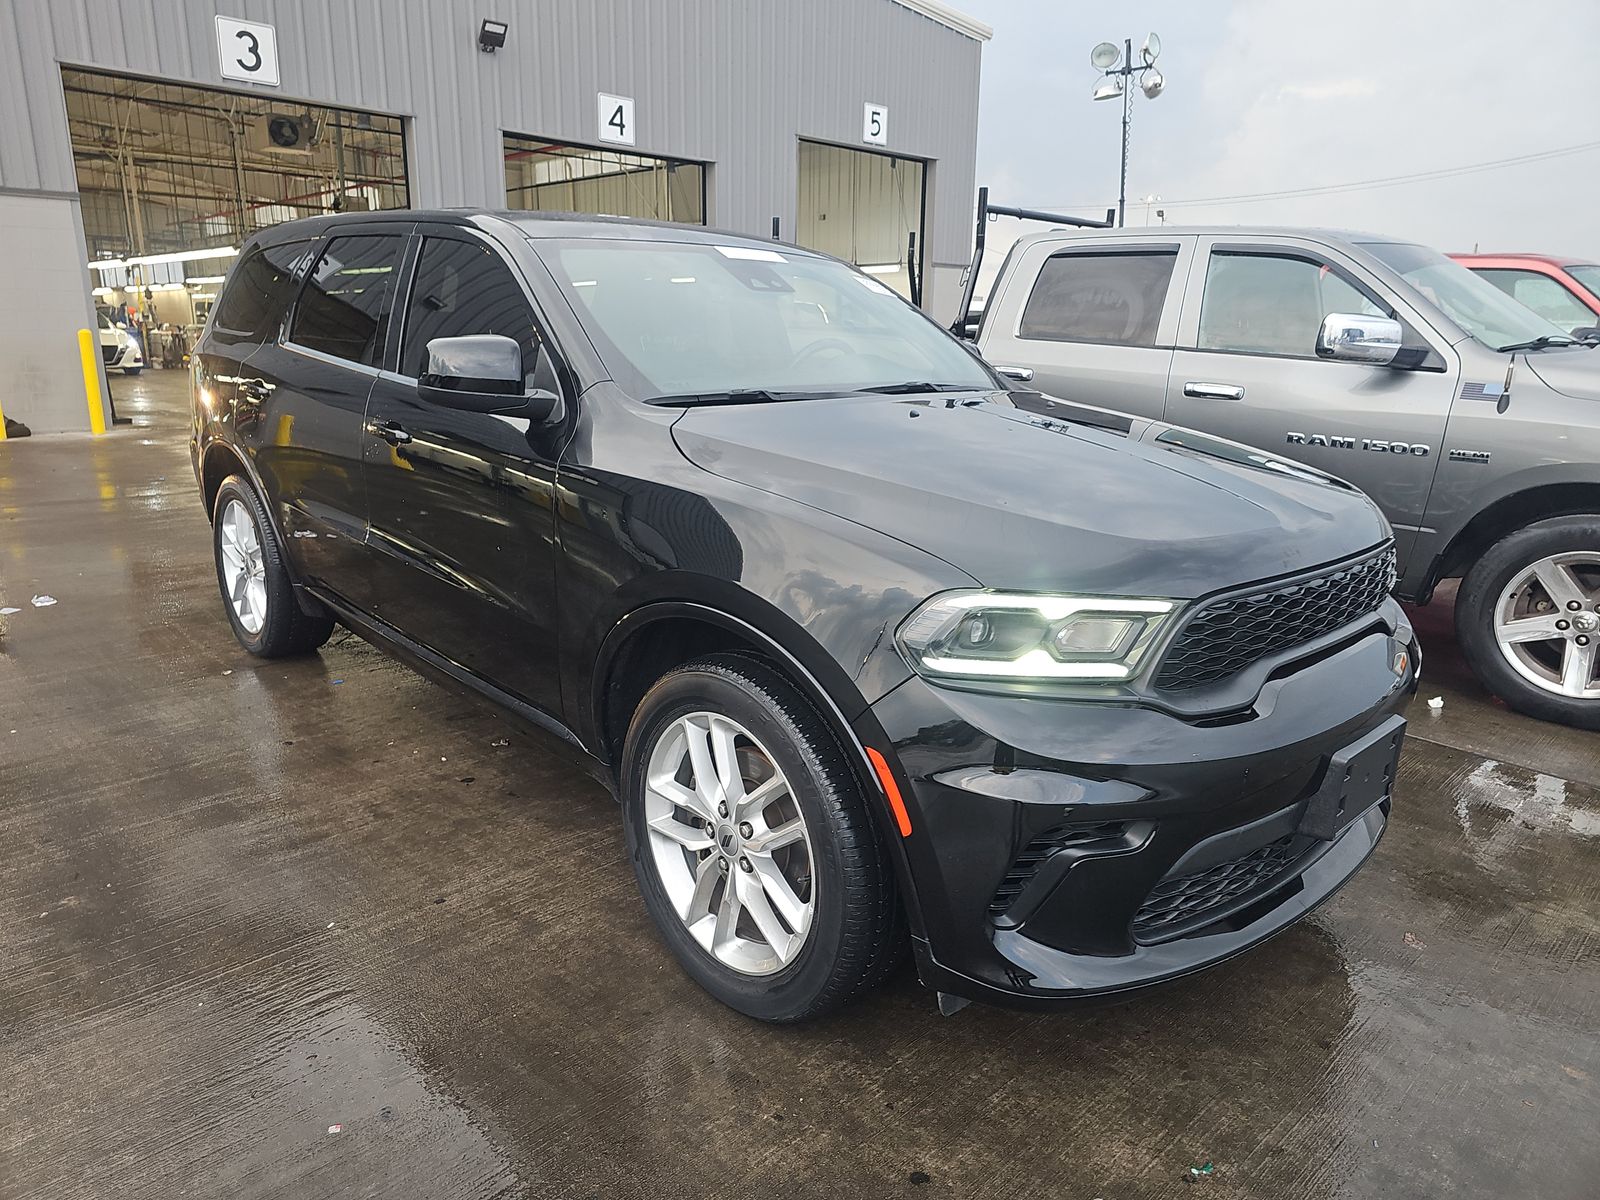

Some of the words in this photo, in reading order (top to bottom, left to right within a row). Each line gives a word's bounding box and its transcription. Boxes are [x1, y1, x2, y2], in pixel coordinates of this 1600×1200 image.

[236, 31, 262, 72] 3
[609, 105, 625, 136] 4
[871, 111, 881, 137] 5
[1286, 431, 1356, 449] RAM
[1362, 439, 1431, 456] 1500
[1449, 449, 1491, 459] HEMI
